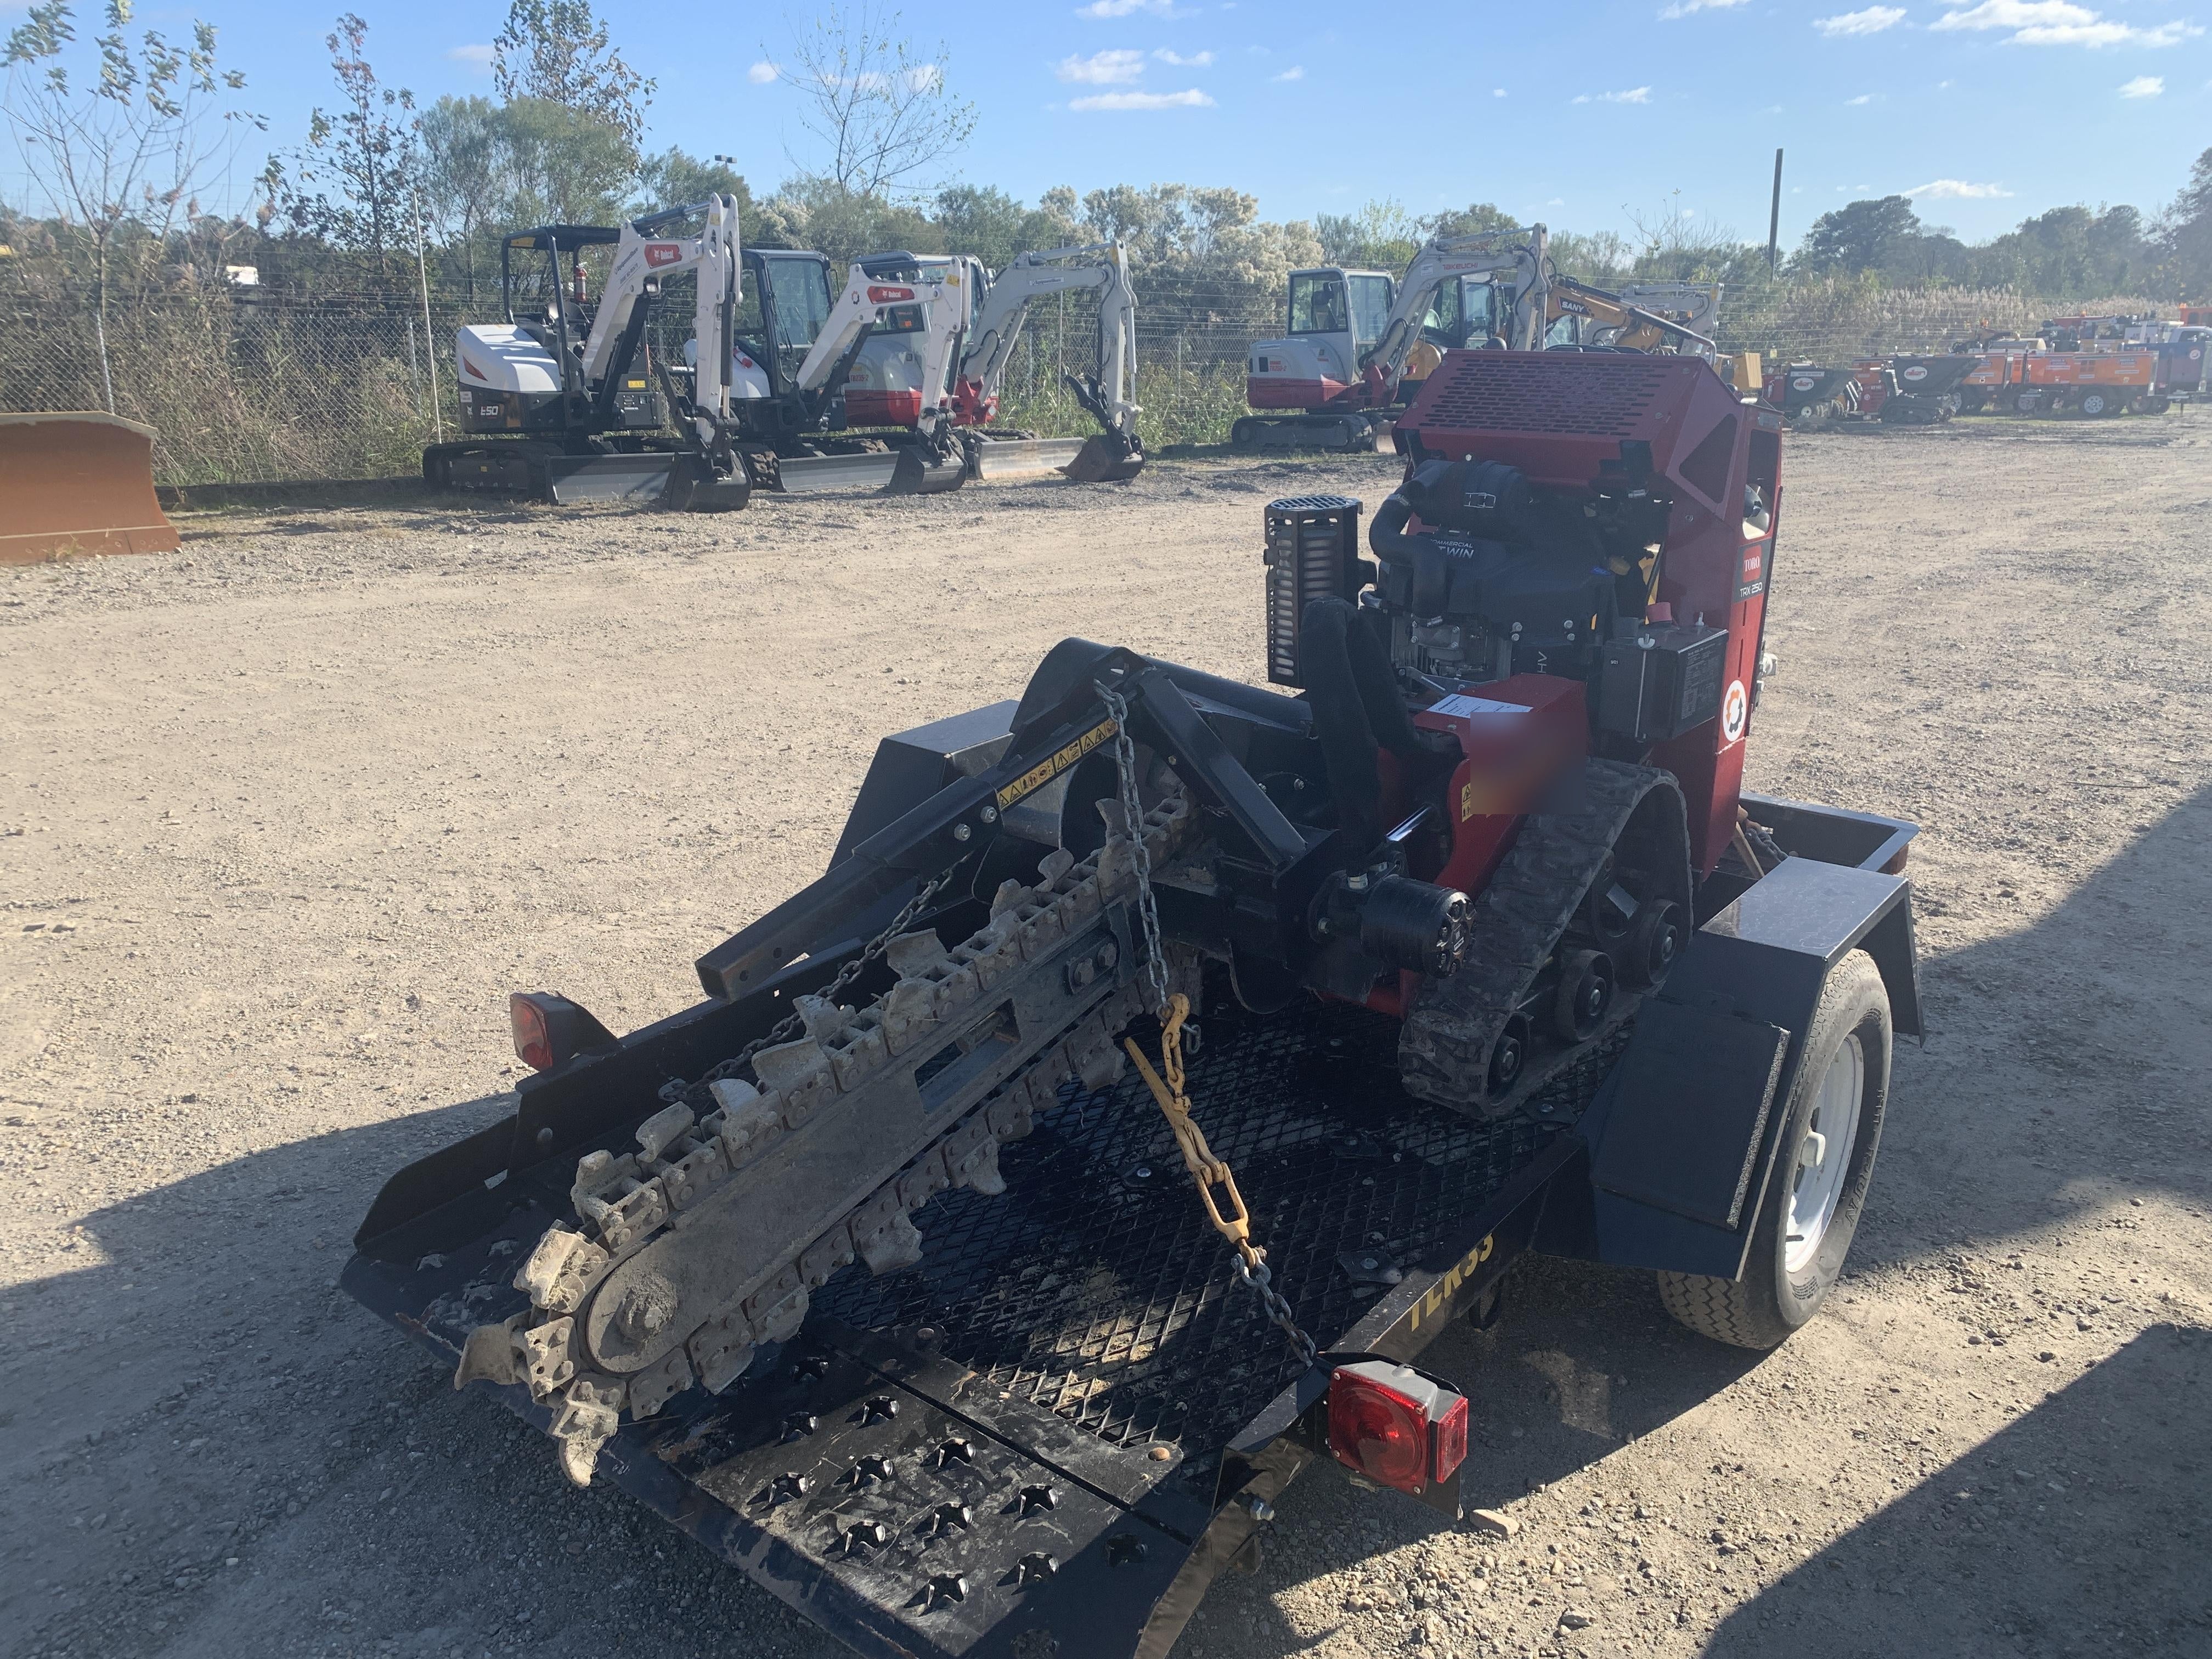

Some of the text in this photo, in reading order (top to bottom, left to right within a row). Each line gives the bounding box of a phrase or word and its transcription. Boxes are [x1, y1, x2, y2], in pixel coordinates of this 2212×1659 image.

[660, 249, 674, 260] Bobcat
[1562, 301, 1585, 312] SANY
[481, 406, 499, 415] E50
[1431, 539, 1473, 548] OMMERCIAL
[1745, 556, 1760, 572] TORO
